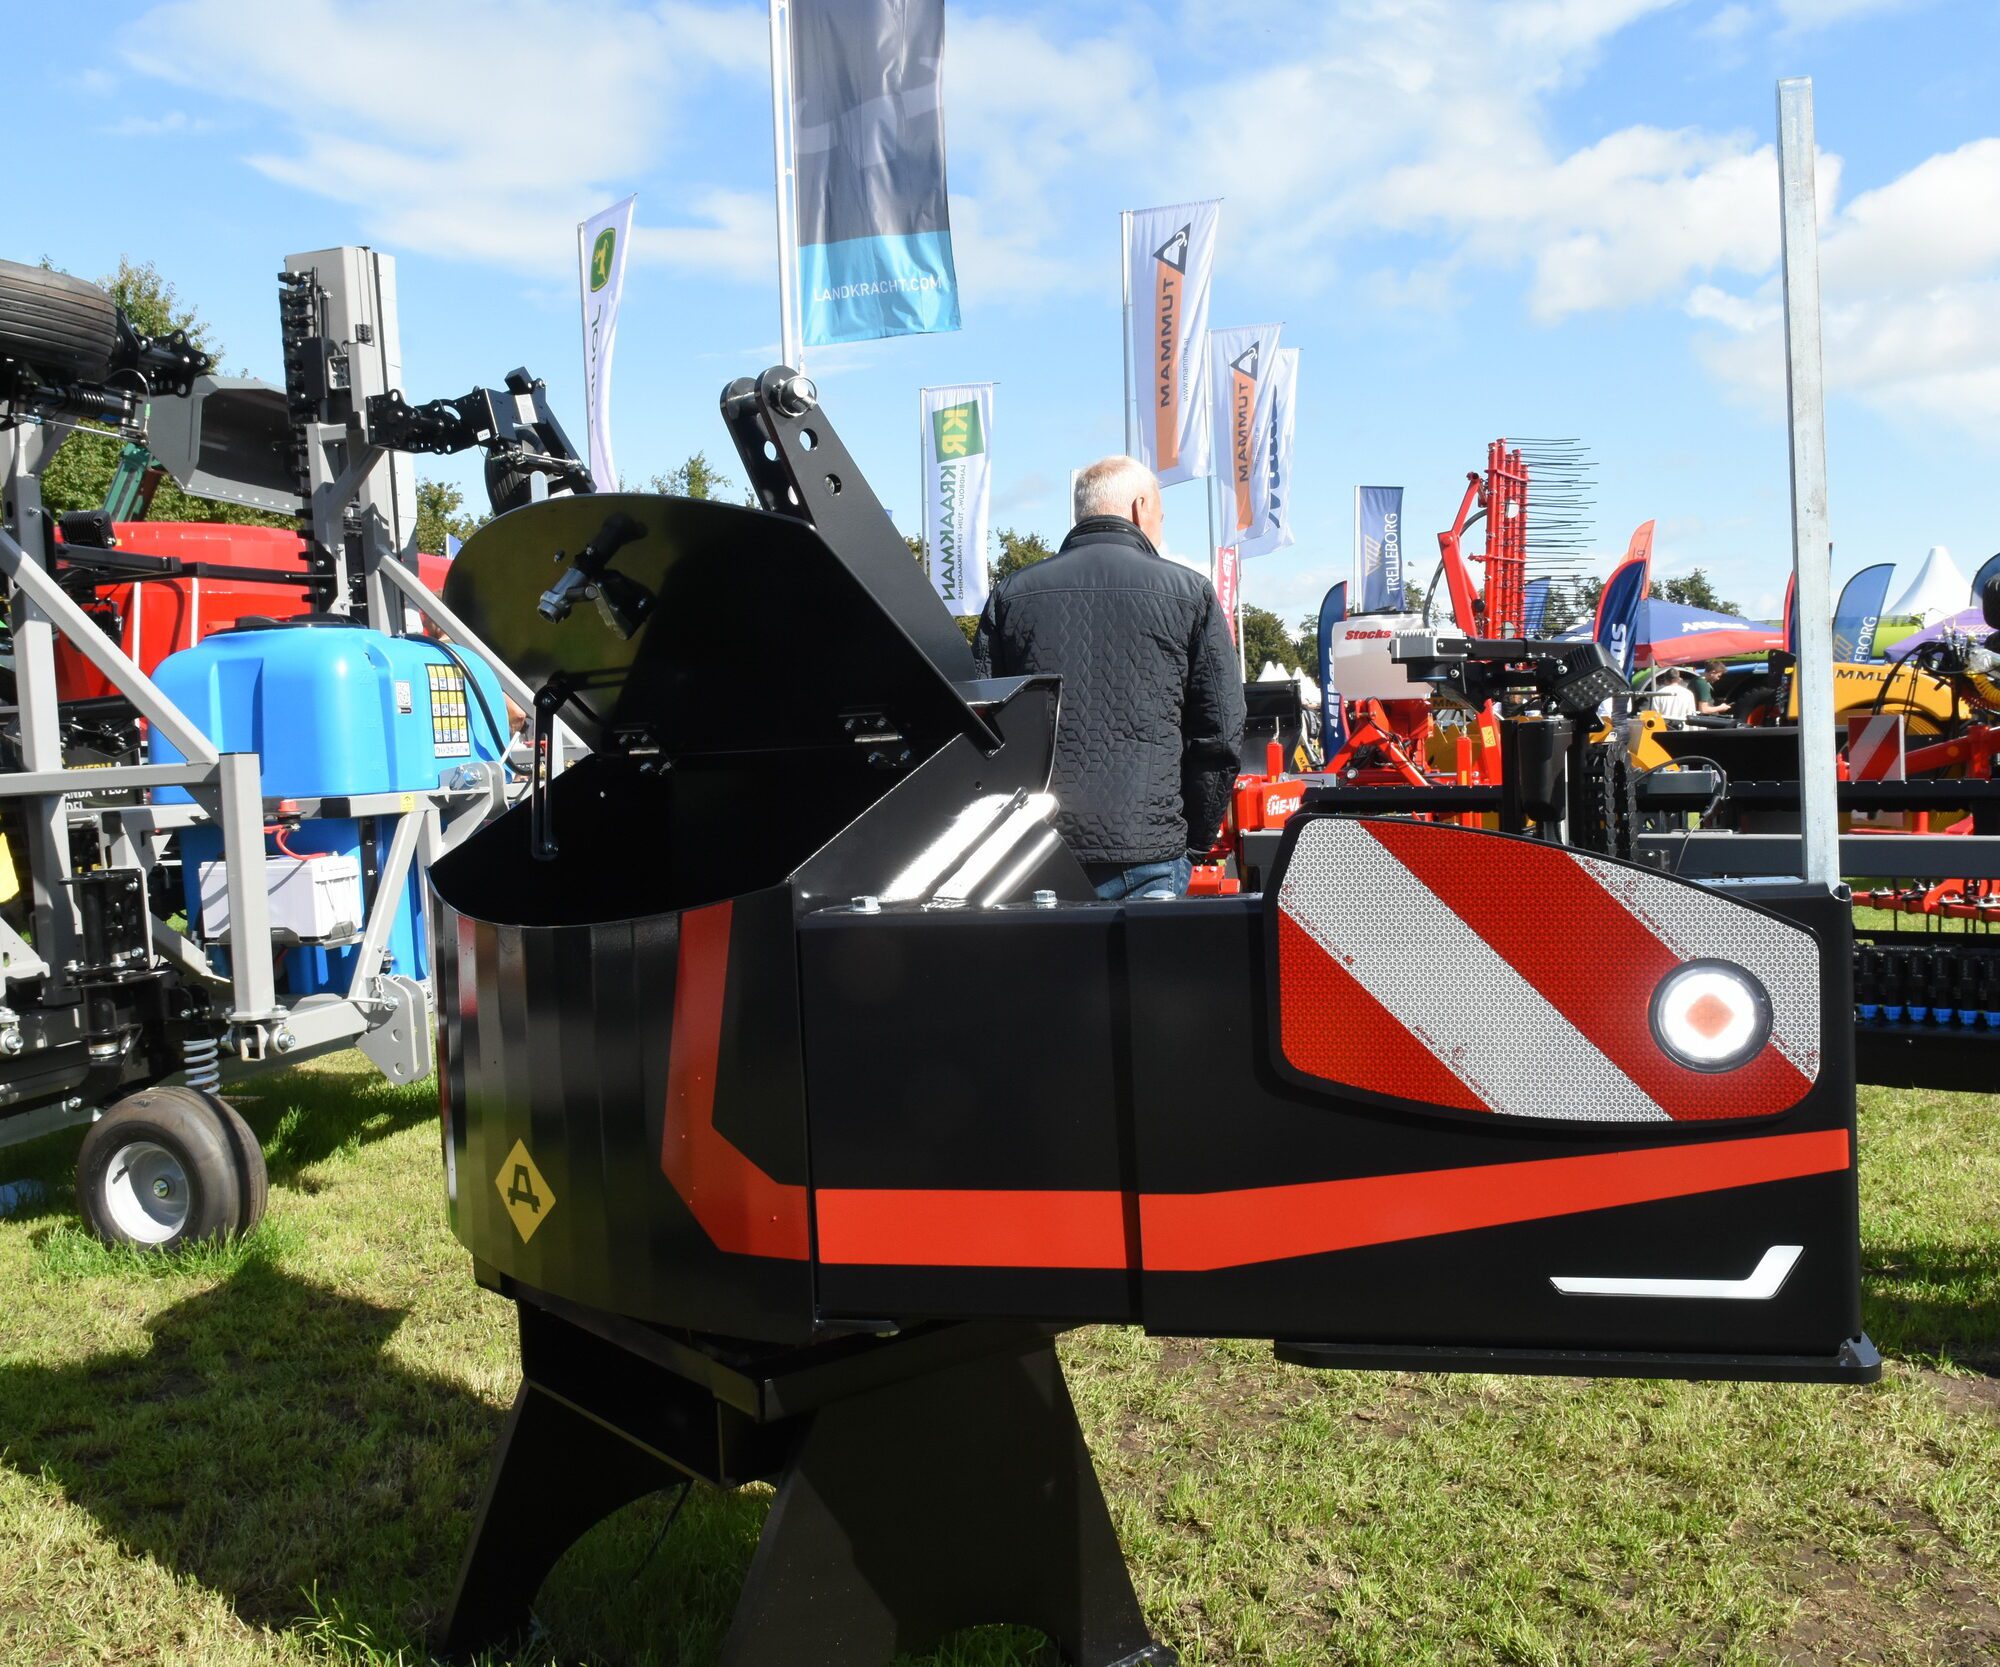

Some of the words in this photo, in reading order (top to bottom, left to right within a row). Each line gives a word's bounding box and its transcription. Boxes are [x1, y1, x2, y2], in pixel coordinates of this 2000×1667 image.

[813, 275, 943, 303] LANDKRACHT.COM
[1160, 277, 1175, 408] MAMMUT
[1238, 382, 1250, 483] MAMMUT
[1222, 552, 1235, 618] HALER
[1385, 512, 1399, 594] TRELLEBORG
[1344, 629, 1393, 641] Stocks
